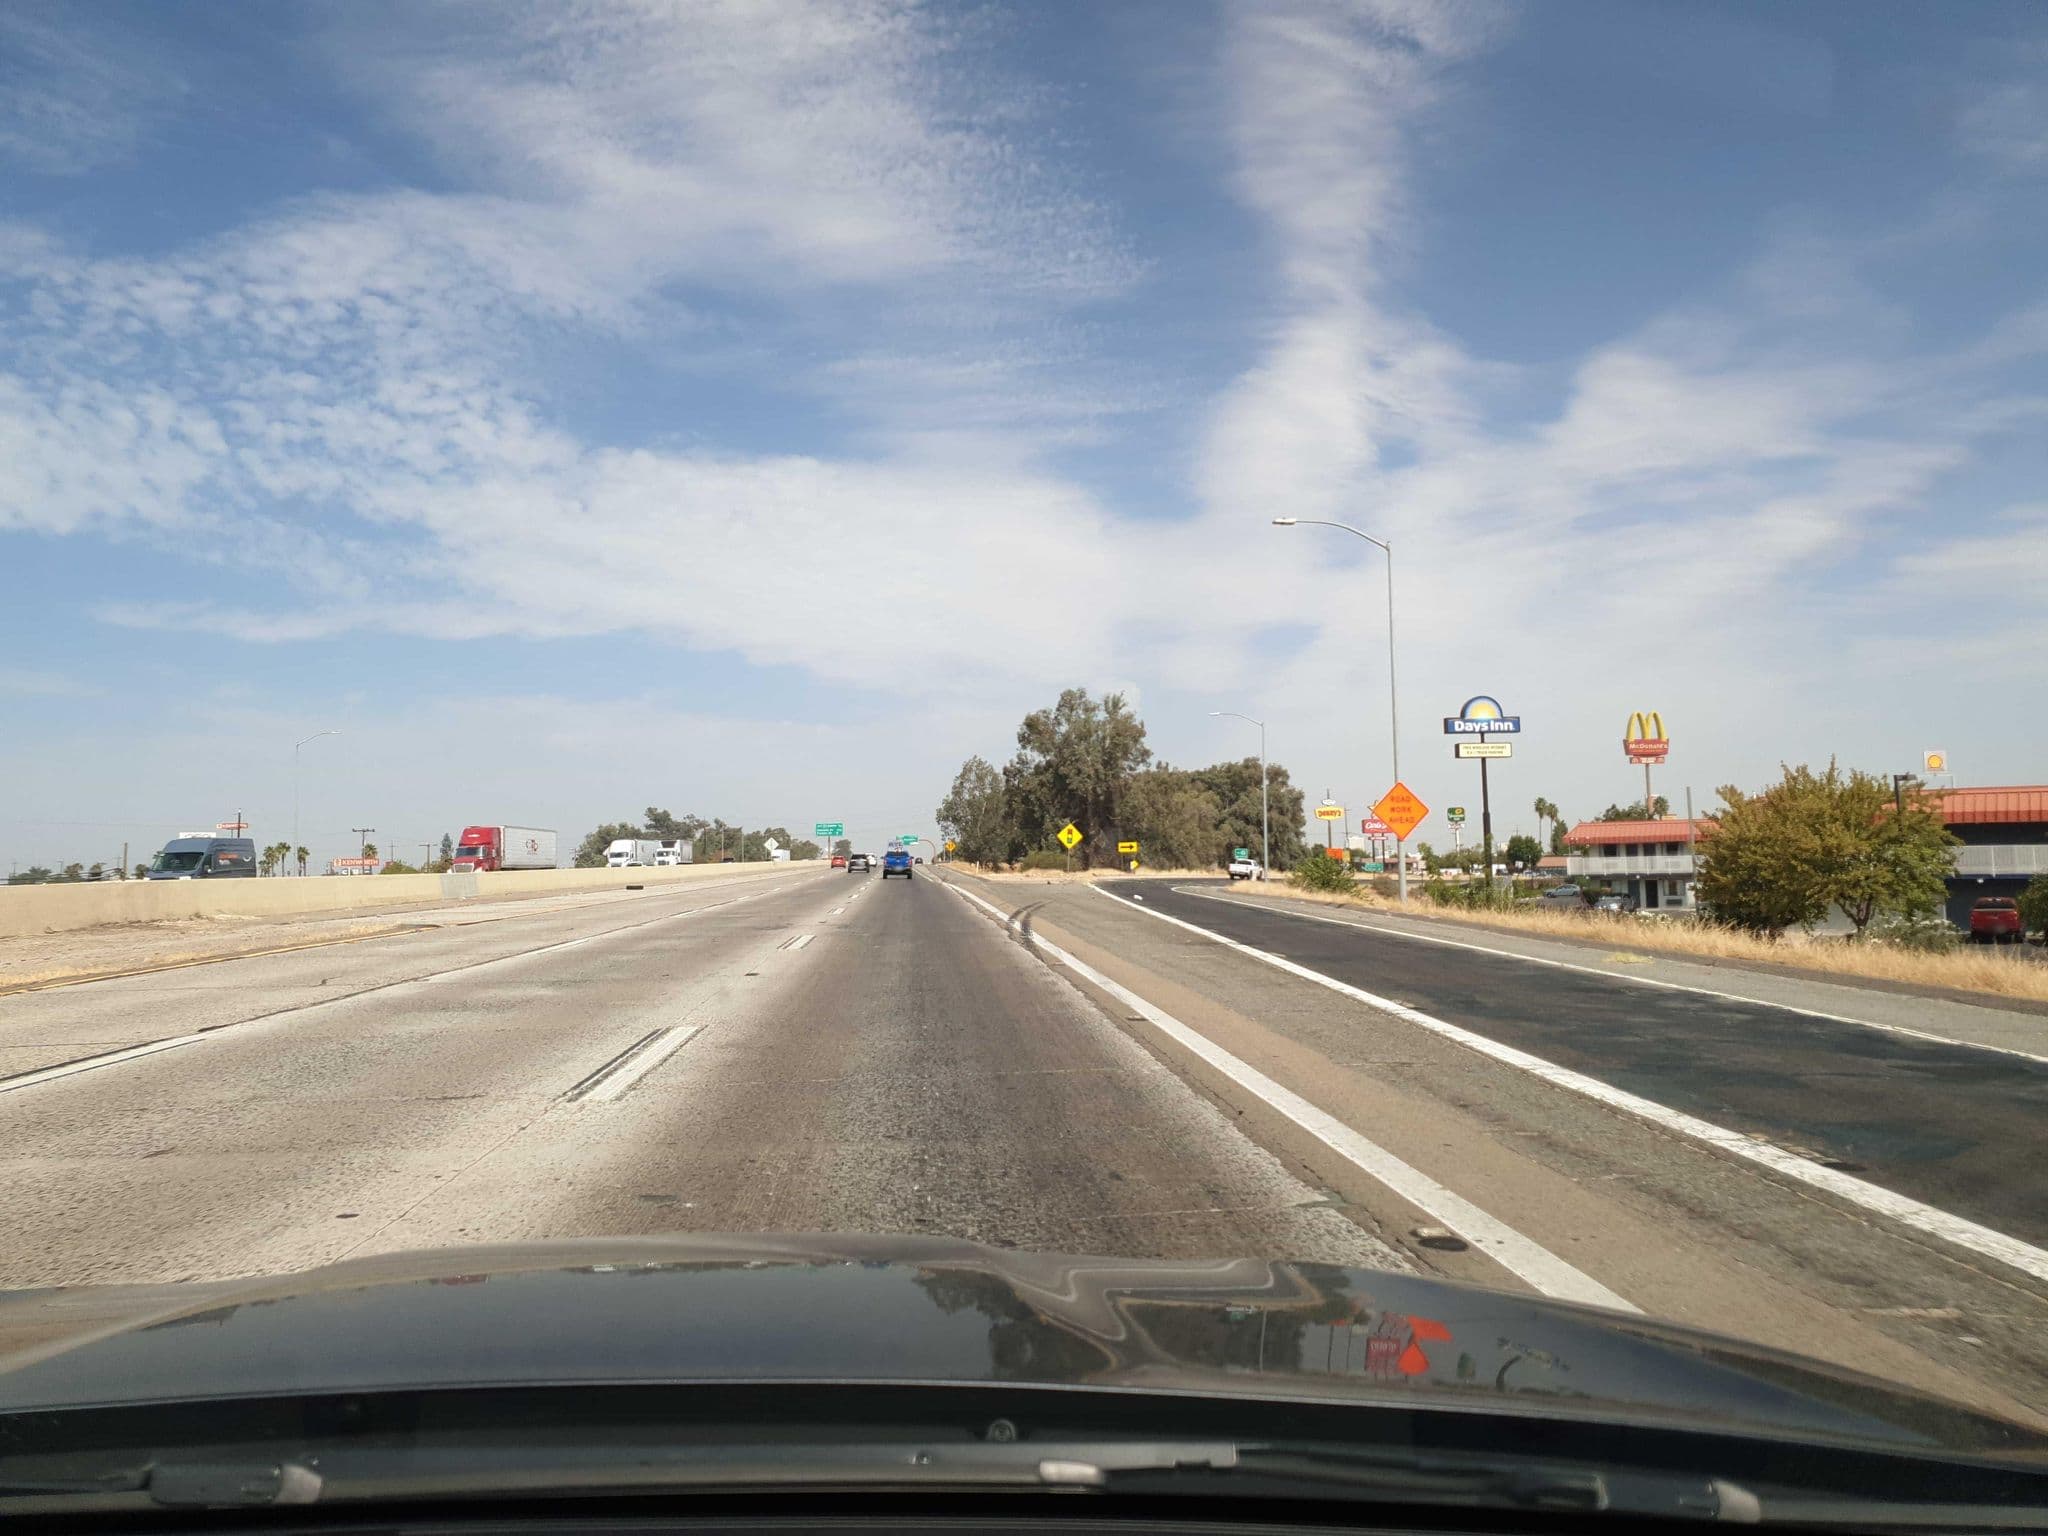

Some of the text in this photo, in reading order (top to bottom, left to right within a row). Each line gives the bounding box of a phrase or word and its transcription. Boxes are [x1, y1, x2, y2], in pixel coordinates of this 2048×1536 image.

[1454, 720, 1513, 732] Days Inn
[1389, 816, 1415, 824] AHEAD
